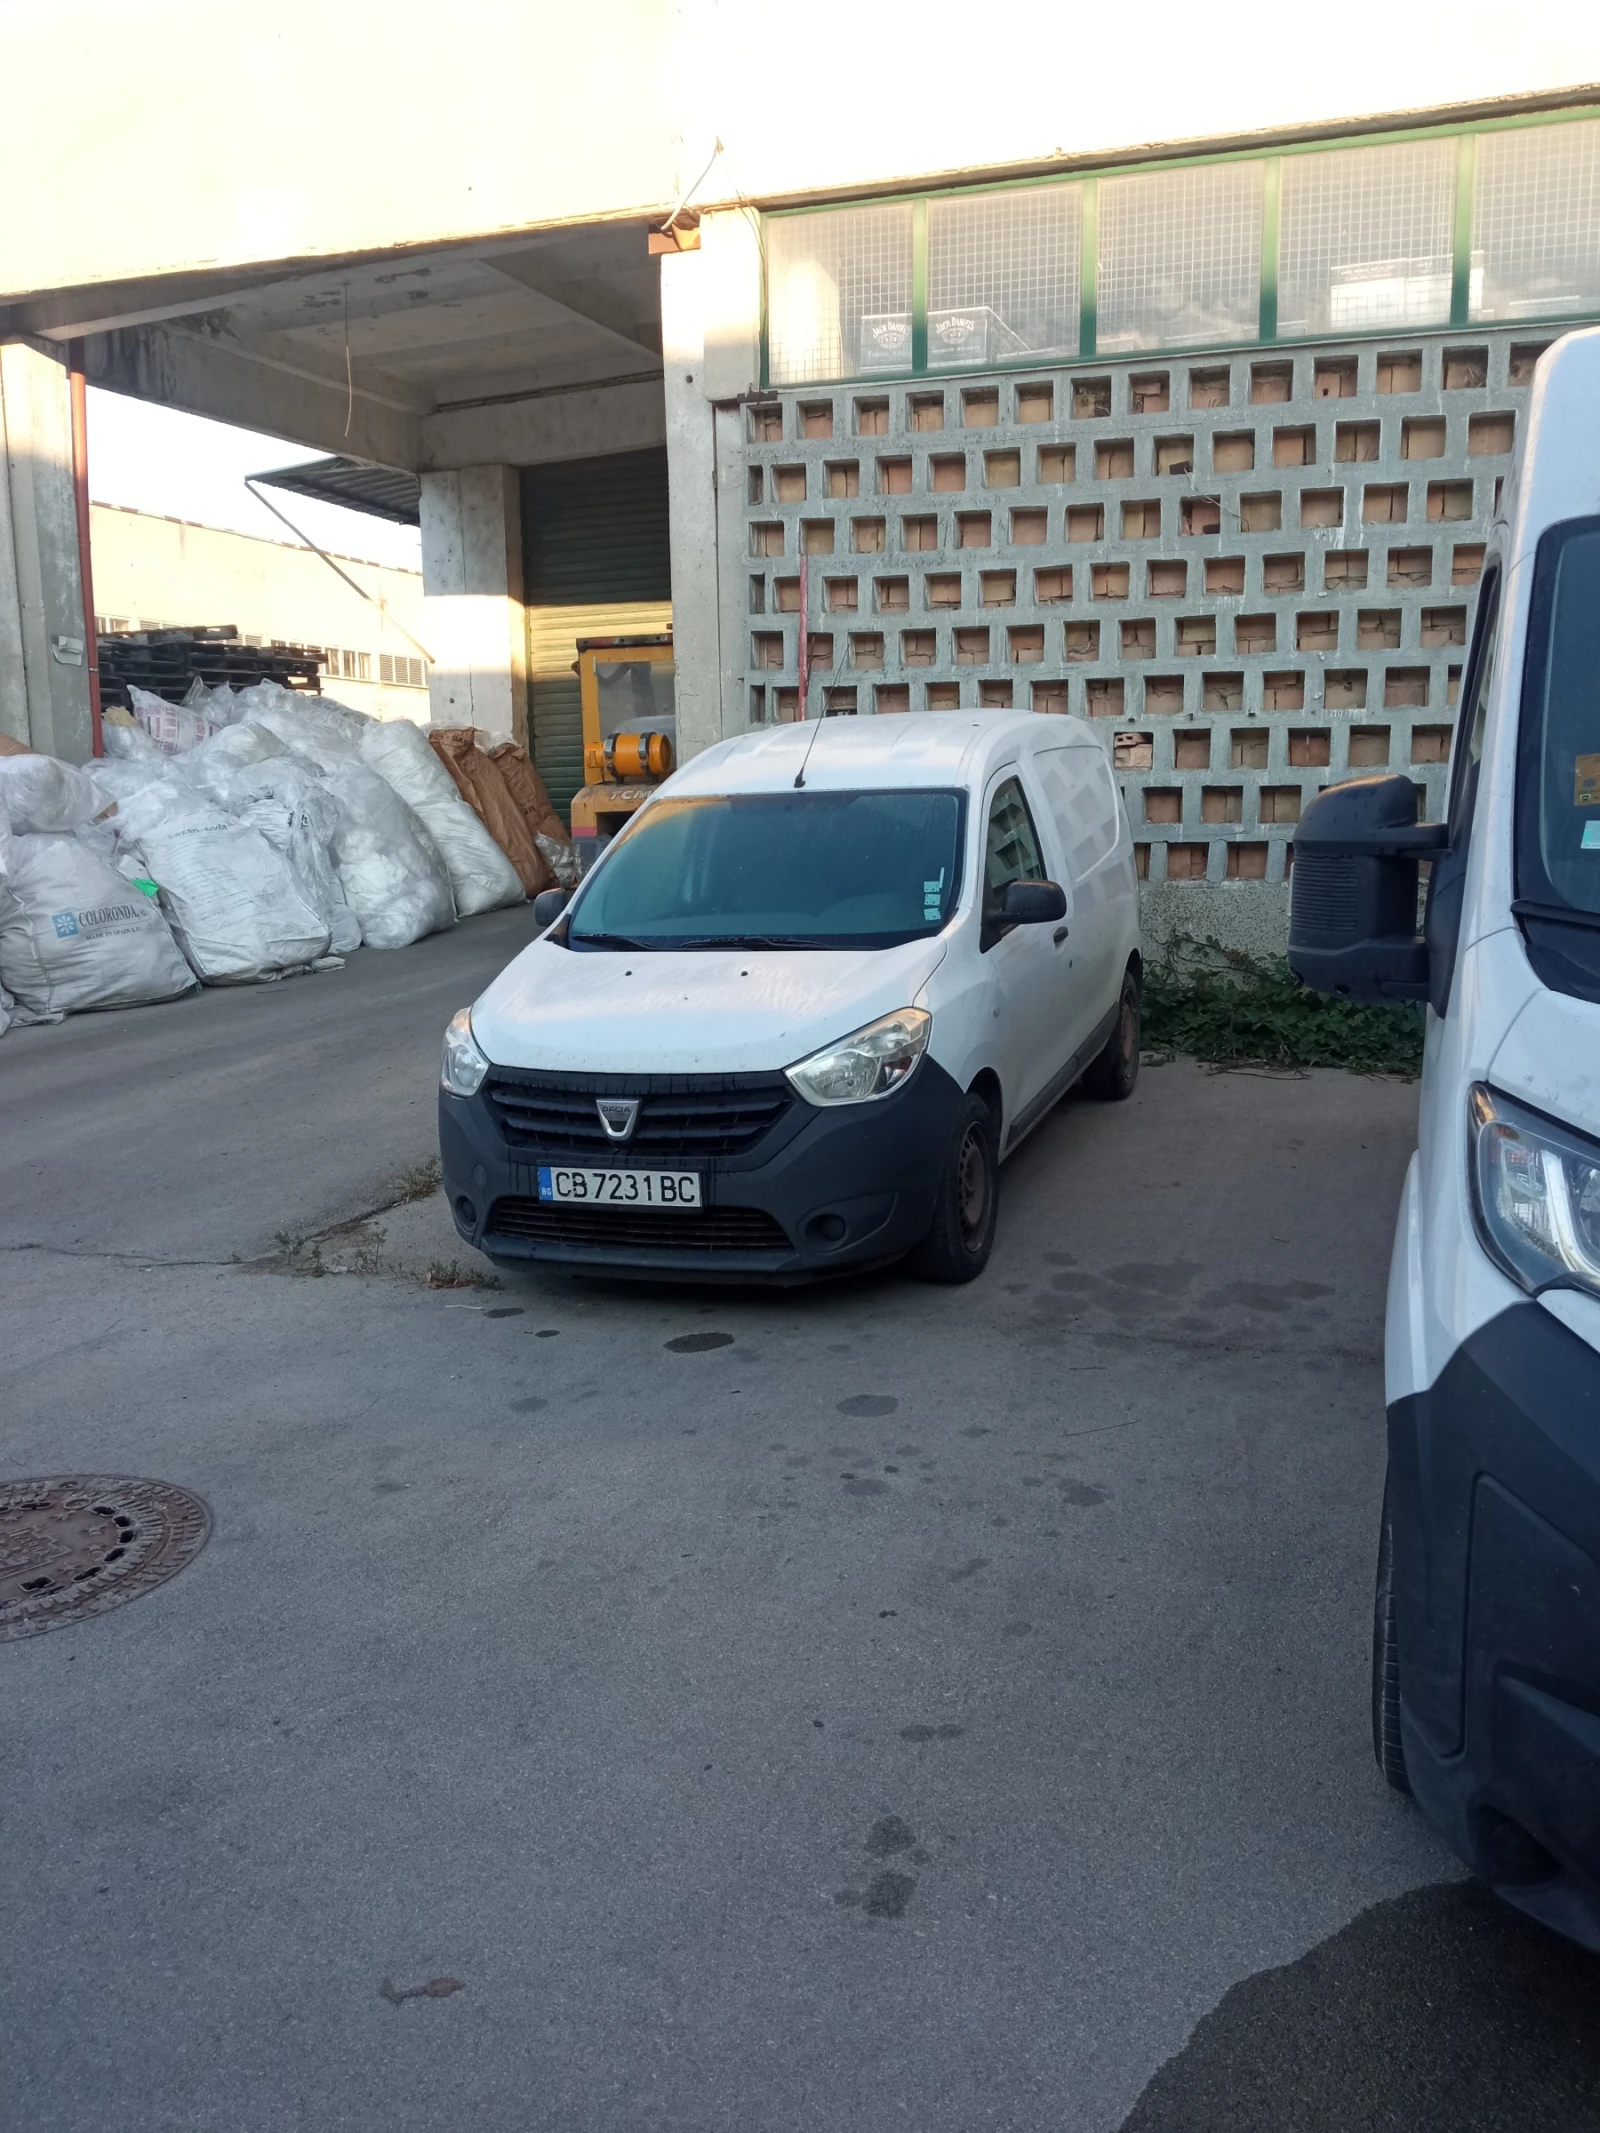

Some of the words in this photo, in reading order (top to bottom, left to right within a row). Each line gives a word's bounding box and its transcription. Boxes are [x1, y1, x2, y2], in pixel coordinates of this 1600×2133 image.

[610, 789, 651, 801] TCM
[86, 932, 104, 940] MADE
[541, 1187, 552, 1196] BG
[592, 1172, 653, 1202] 7231
[660, 1175, 695, 1203] BC
